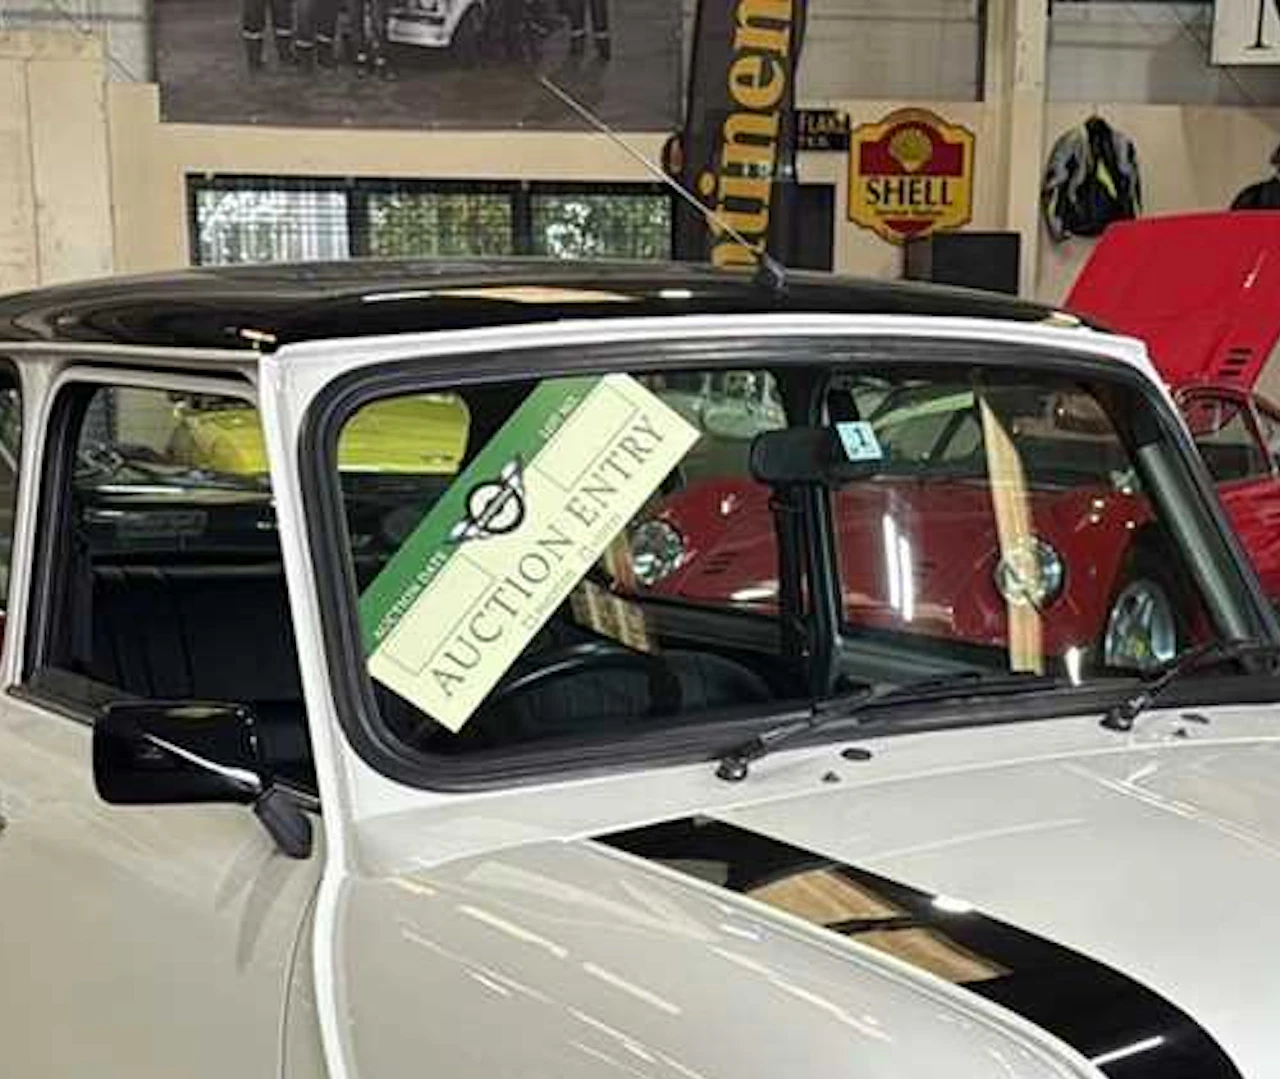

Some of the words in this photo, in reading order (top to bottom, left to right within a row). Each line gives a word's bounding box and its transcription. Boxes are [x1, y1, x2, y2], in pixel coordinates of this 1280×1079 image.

[865, 177, 954, 206] SHELL
[429, 524, 576, 697] AUCTION
[566, 414, 665, 528] ENTRY
